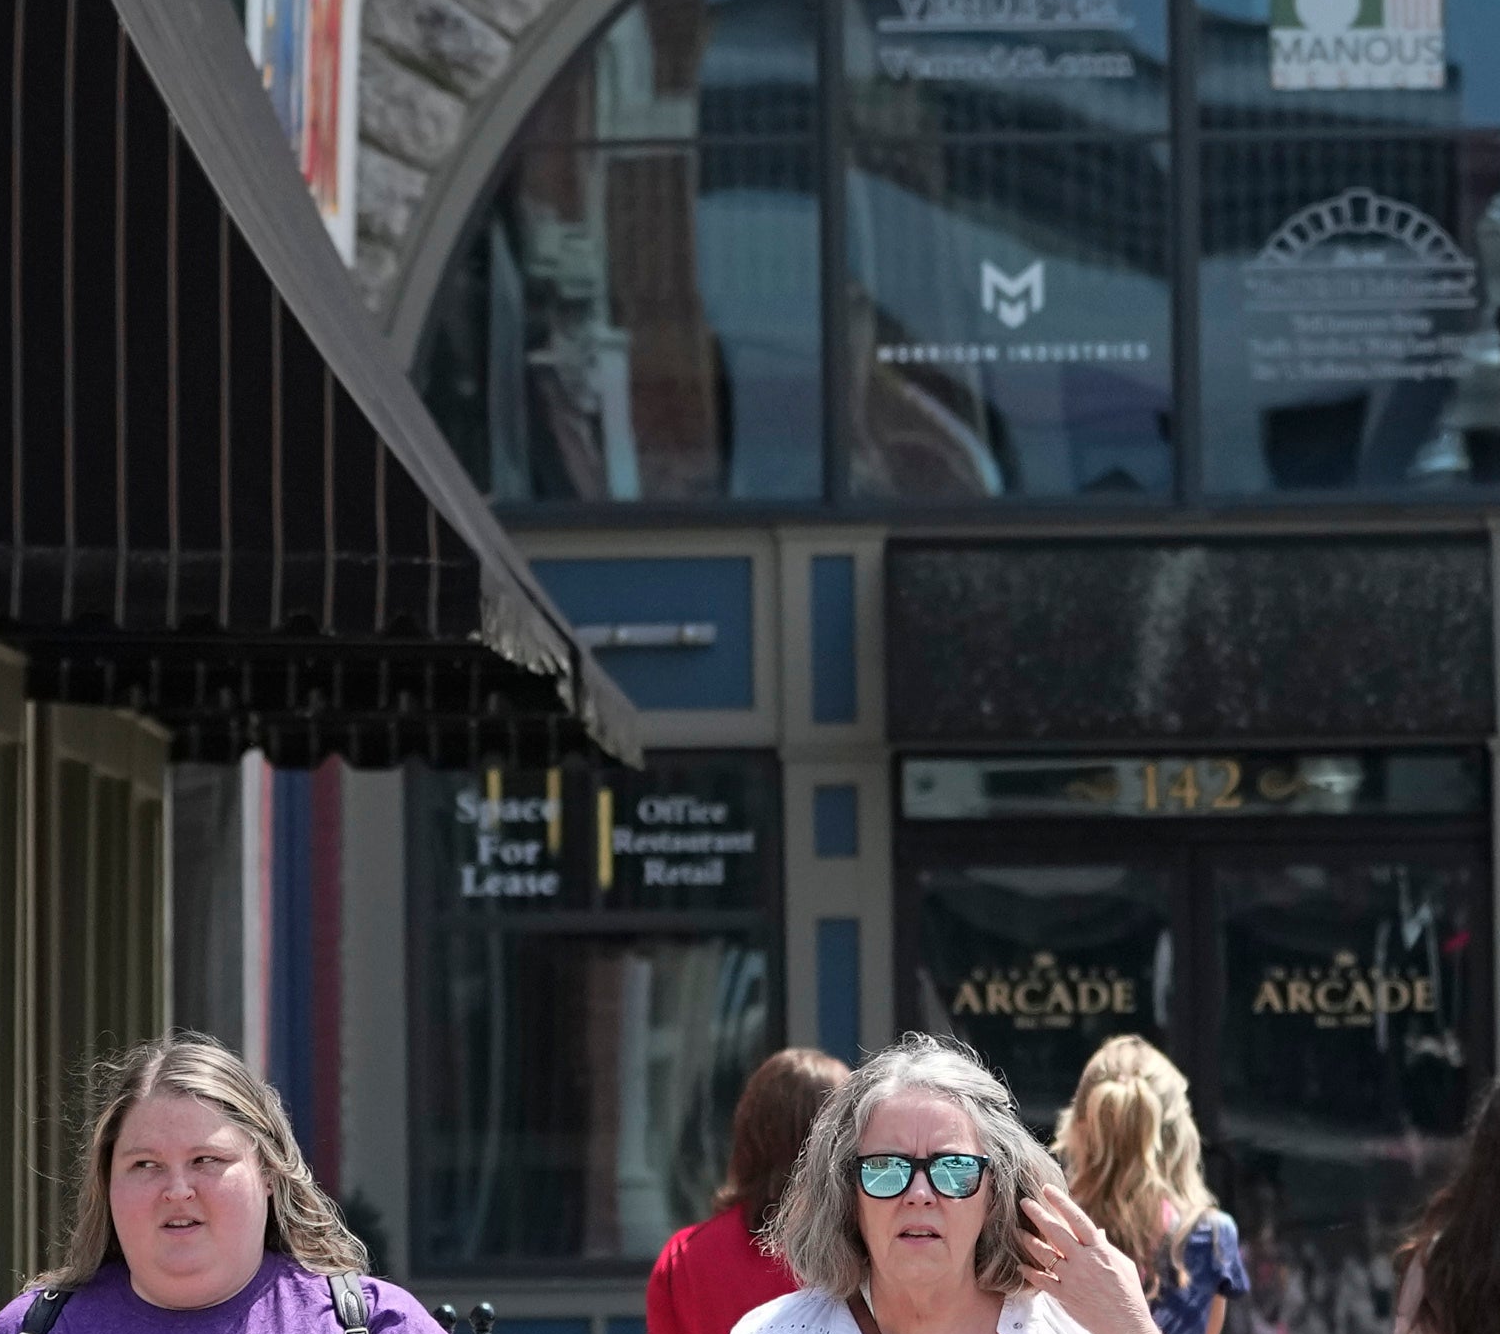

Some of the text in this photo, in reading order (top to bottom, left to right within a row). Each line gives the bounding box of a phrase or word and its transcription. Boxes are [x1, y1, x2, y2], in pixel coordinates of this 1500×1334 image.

[1272, 35, 1443, 65] MANOUS
[1142, 761, 1245, 810] 142
[456, 789, 562, 831] Space
[637, 796, 728, 824] Office
[477, 833, 542, 866] For
[611, 826, 755, 854] Restaurant
[460, 865, 561, 898] Lease
[644, 857, 726, 886] Retail
[952, 980, 1137, 1015] ARCADE
[1252, 980, 1437, 1015] ARCADE
